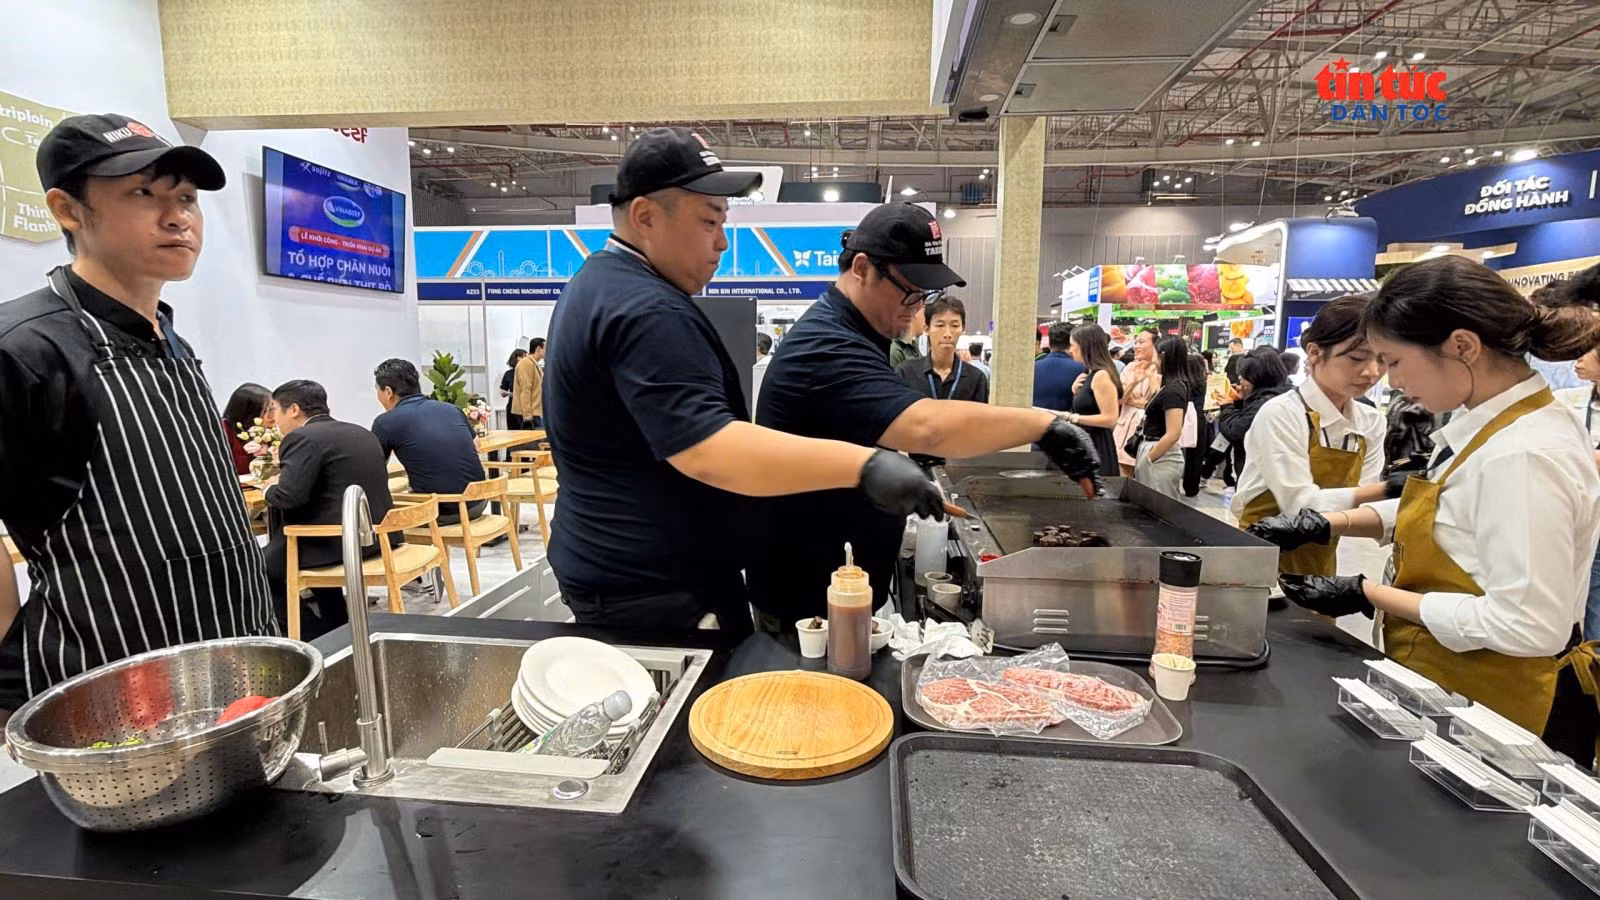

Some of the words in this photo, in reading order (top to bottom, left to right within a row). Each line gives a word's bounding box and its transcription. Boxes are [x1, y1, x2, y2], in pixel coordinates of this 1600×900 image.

[1514, 175, 1551, 192] TÁC
[1515, 190, 1569, 208] HÀNH
[16, 202, 49, 218] Thin
[308, 254, 334, 272] HỢP
[368, 263, 391, 277] NUÔI
[813, 250, 841, 267] Tai
